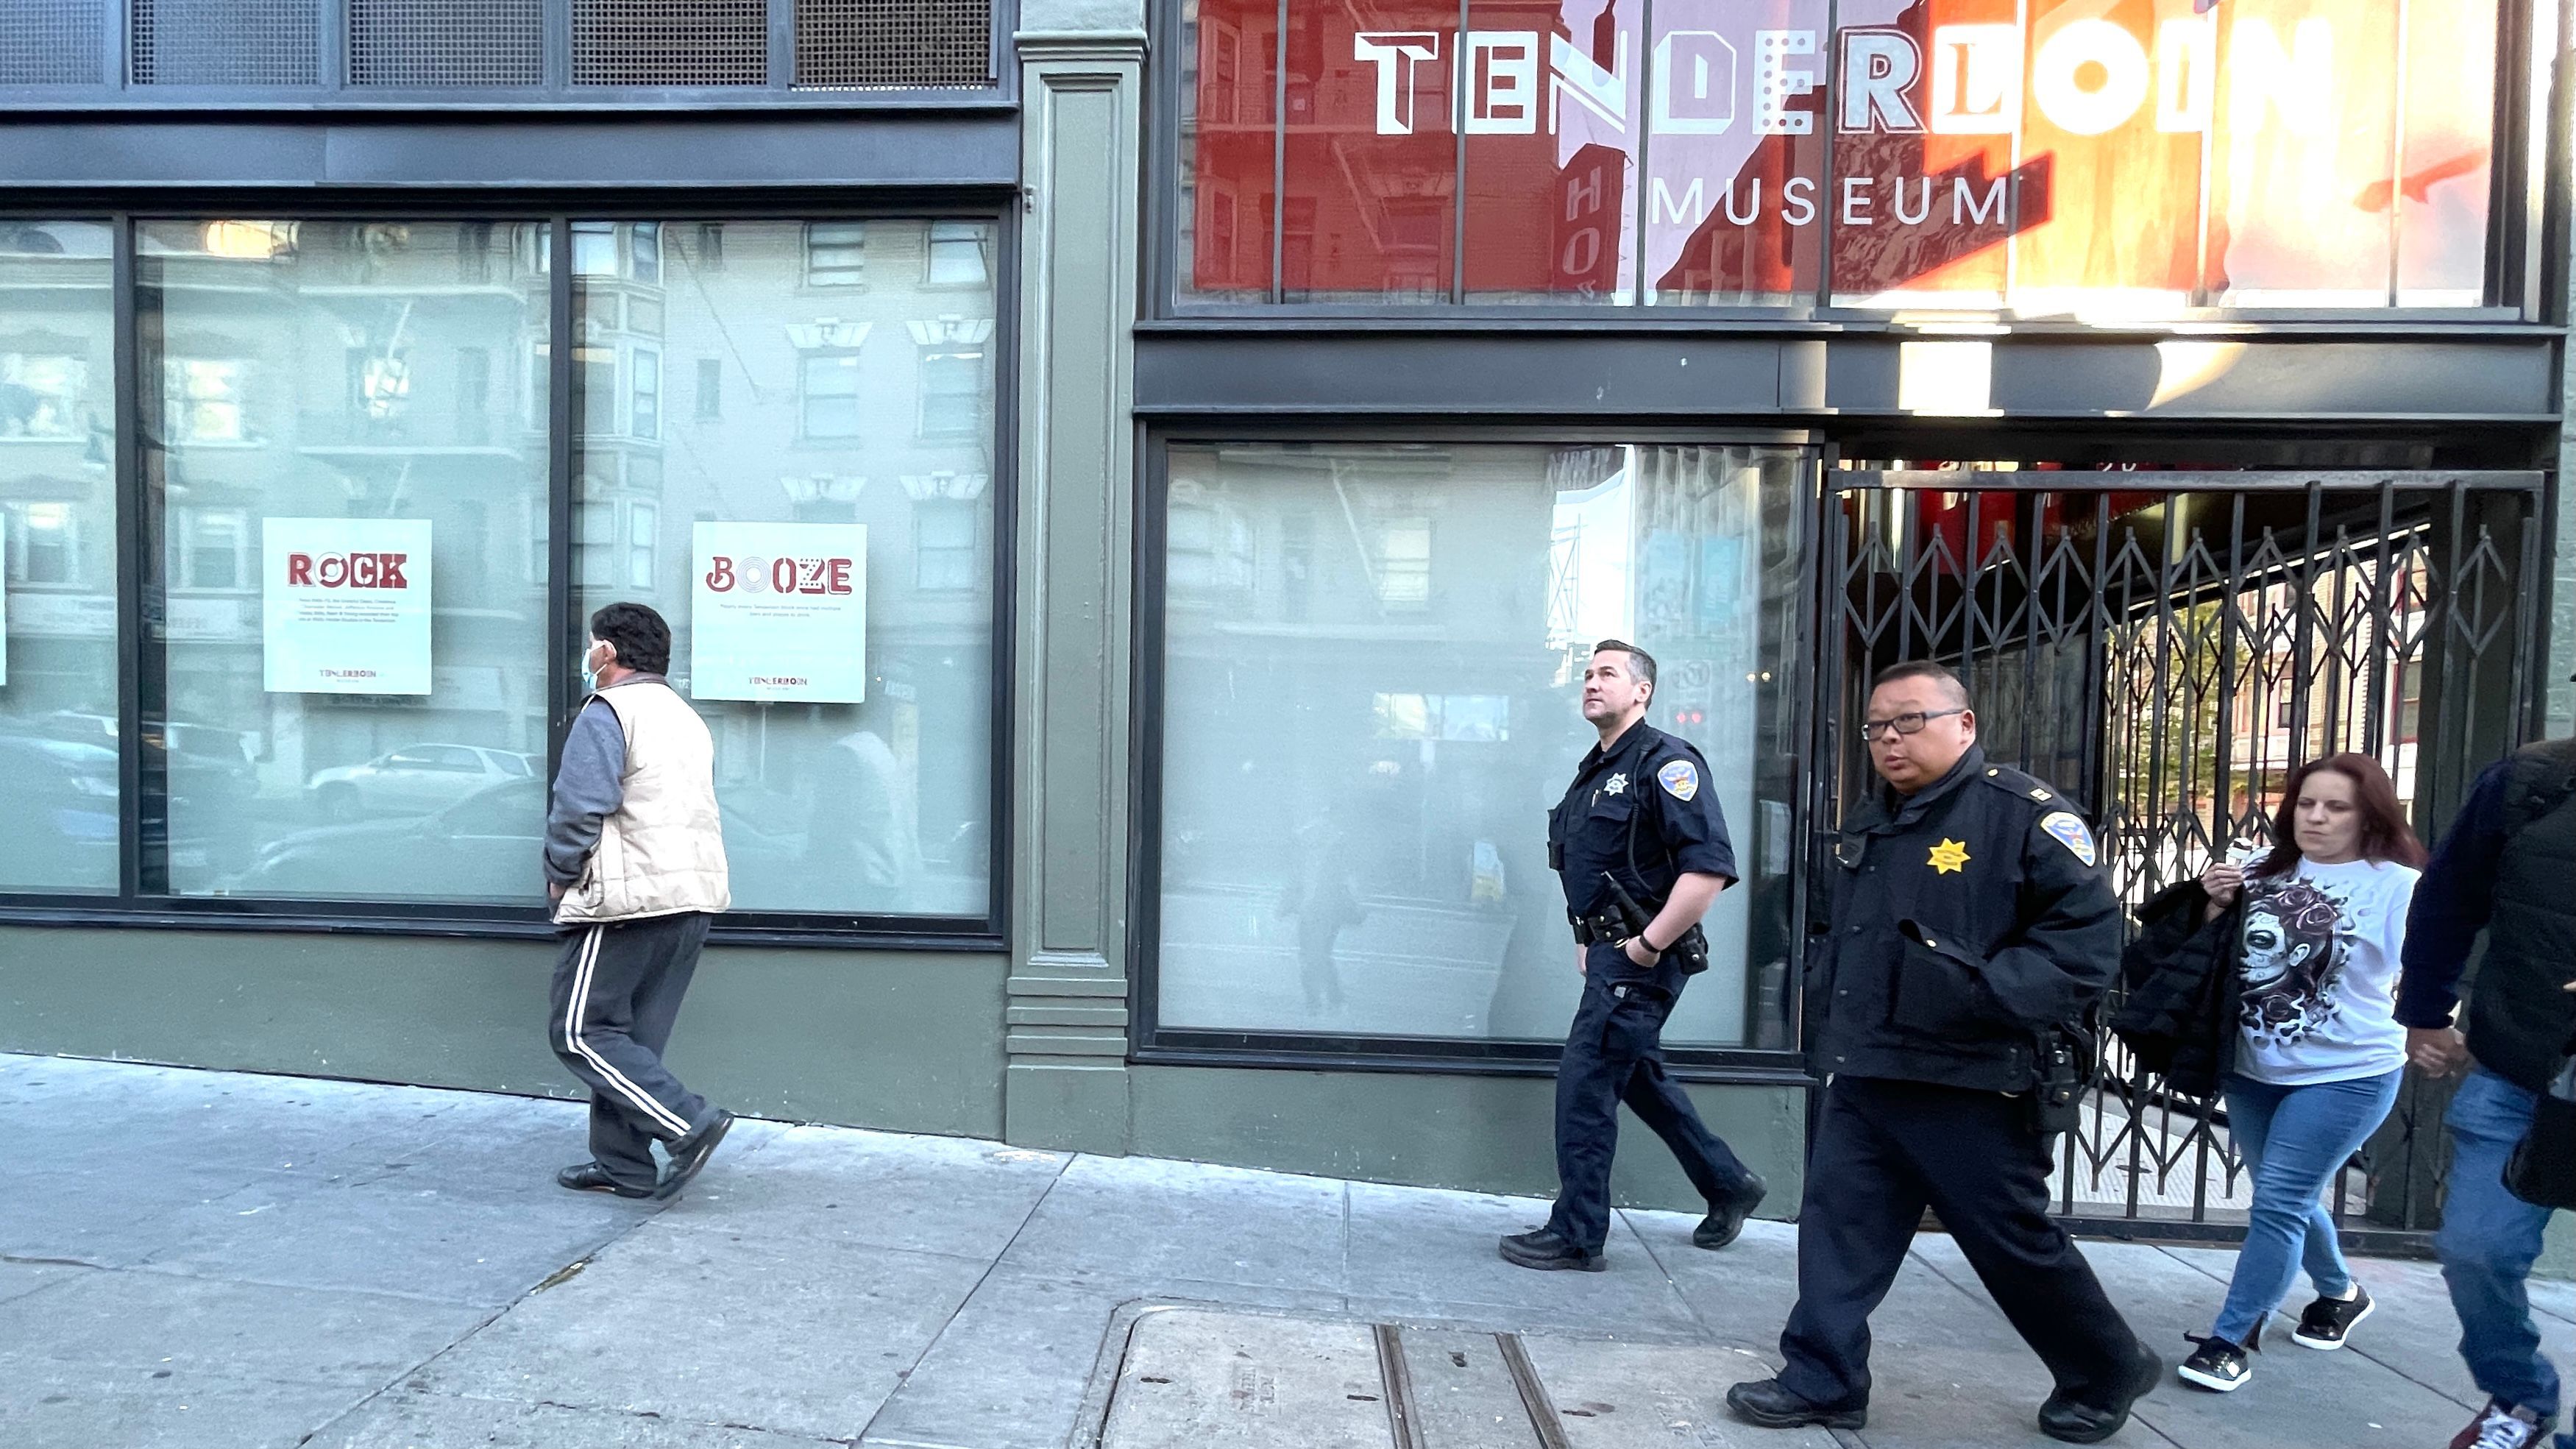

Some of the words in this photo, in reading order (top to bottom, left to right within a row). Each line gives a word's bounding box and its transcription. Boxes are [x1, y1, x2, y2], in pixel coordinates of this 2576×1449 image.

[1354, 19, 2334, 136] TENDERLOIN
[1651, 177, 2007, 226] MUSEUM
[288, 553, 407, 589] ROCK
[706, 556, 852, 595] BOOZE
